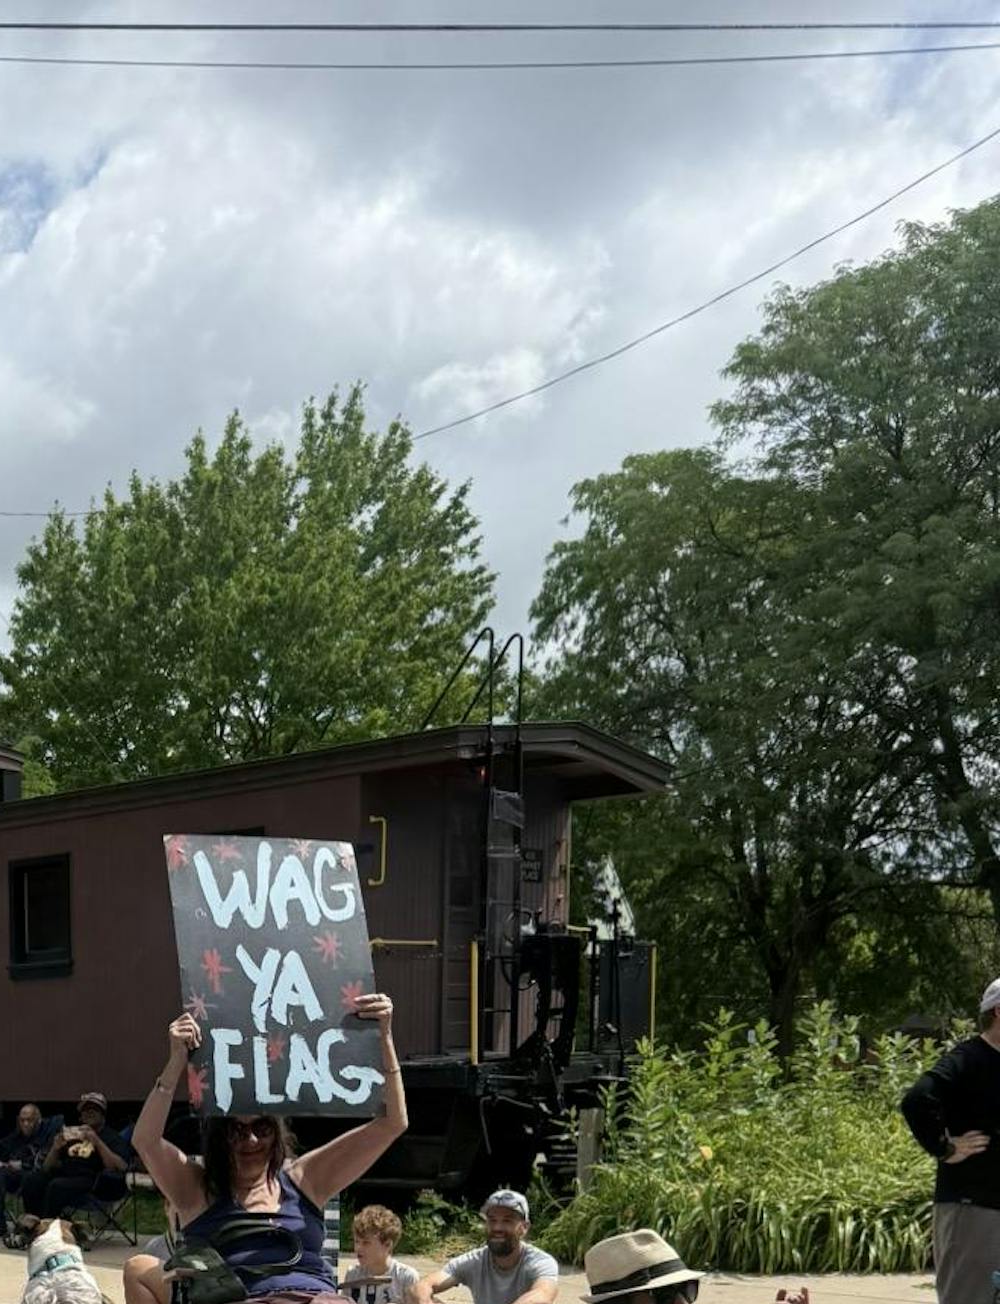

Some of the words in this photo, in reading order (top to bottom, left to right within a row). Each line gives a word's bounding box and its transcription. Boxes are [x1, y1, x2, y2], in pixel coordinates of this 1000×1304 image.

[193, 841, 356, 930] WAG
[236, 944, 324, 1033] YA
[210, 1028, 386, 1114] FLAG
